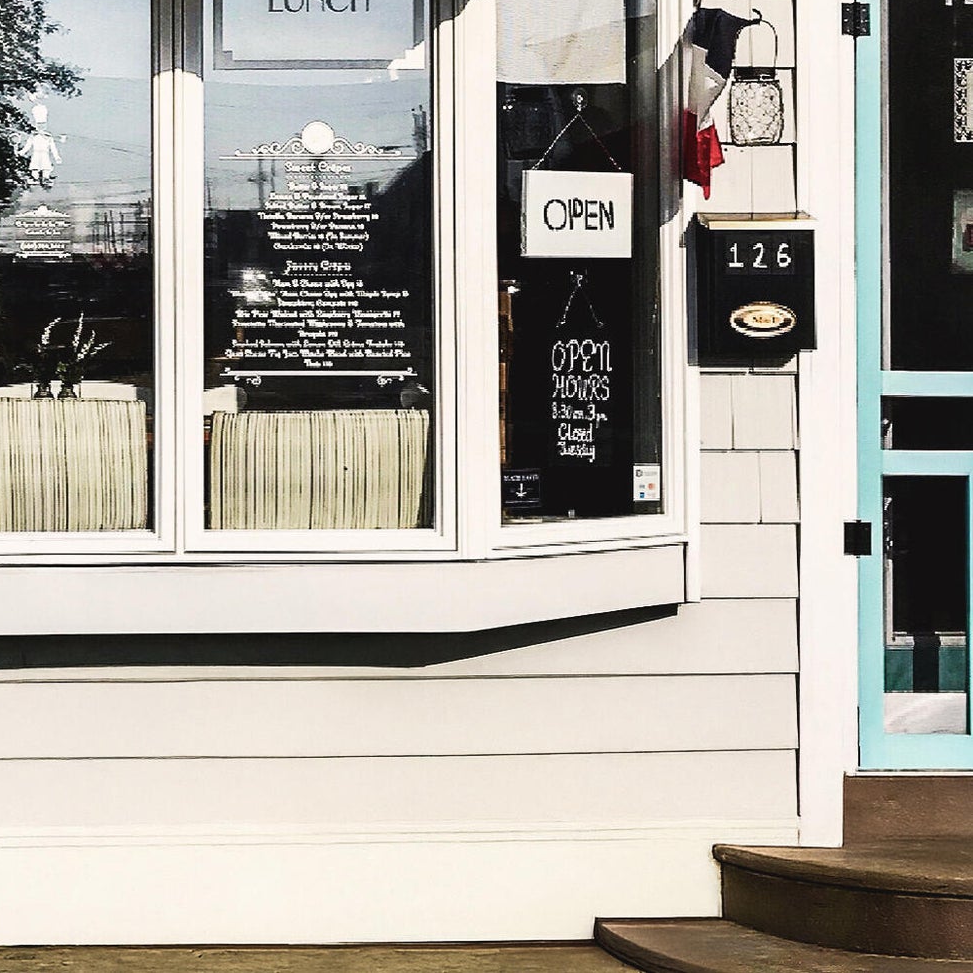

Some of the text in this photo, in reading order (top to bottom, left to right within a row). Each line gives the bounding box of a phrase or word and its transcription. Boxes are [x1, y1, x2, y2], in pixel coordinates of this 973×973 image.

[543, 197, 615, 231] OPEN
[728, 242, 792, 268] 126
[551, 339, 612, 373] OPEN
[552, 374, 610, 401] HOURS
